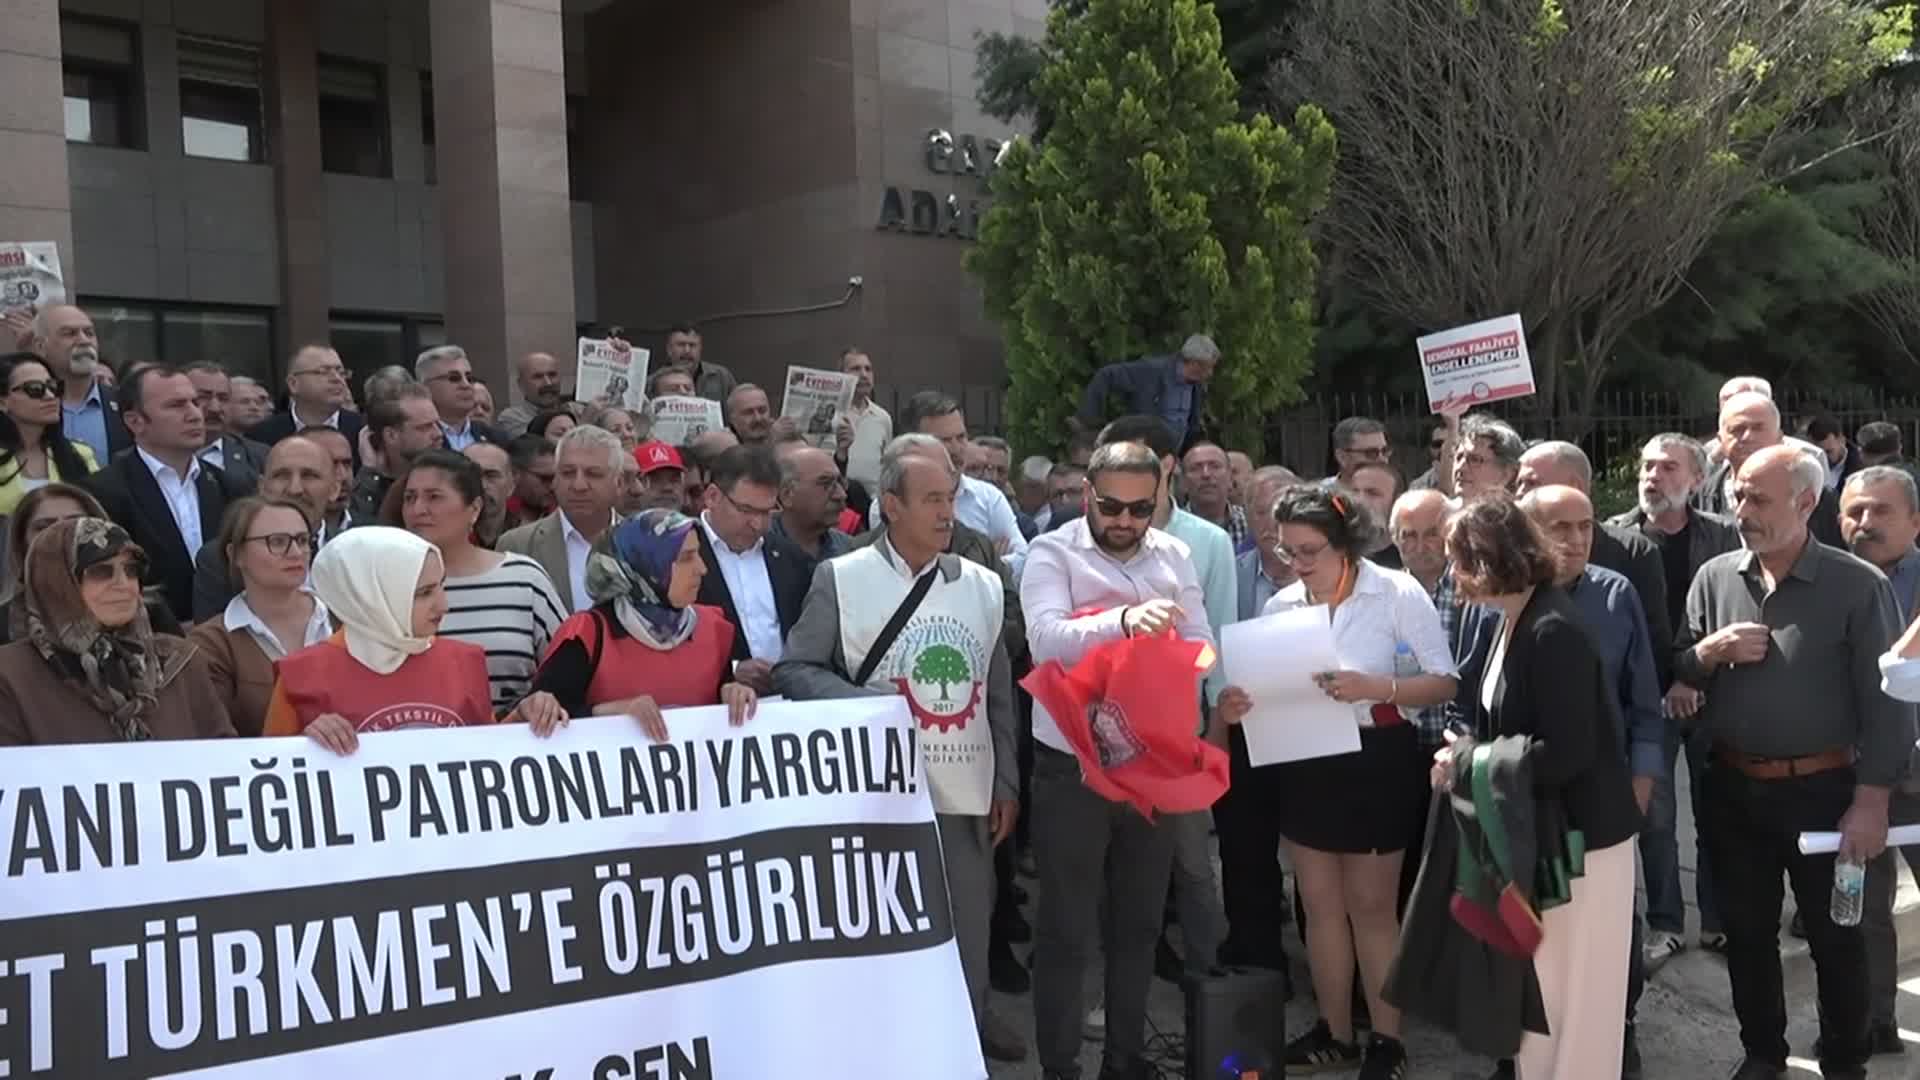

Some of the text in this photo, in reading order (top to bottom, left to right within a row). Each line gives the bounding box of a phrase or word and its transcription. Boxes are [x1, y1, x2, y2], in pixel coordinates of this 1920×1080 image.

[932, 703, 954, 713] 2017
[0, 726, 916, 877] ANI DEĞİL PATRONLARI YARGILA!
[0, 953, 65, 1077] T
[595, 836, 932, 975] ÖZGÜRLÜK!
